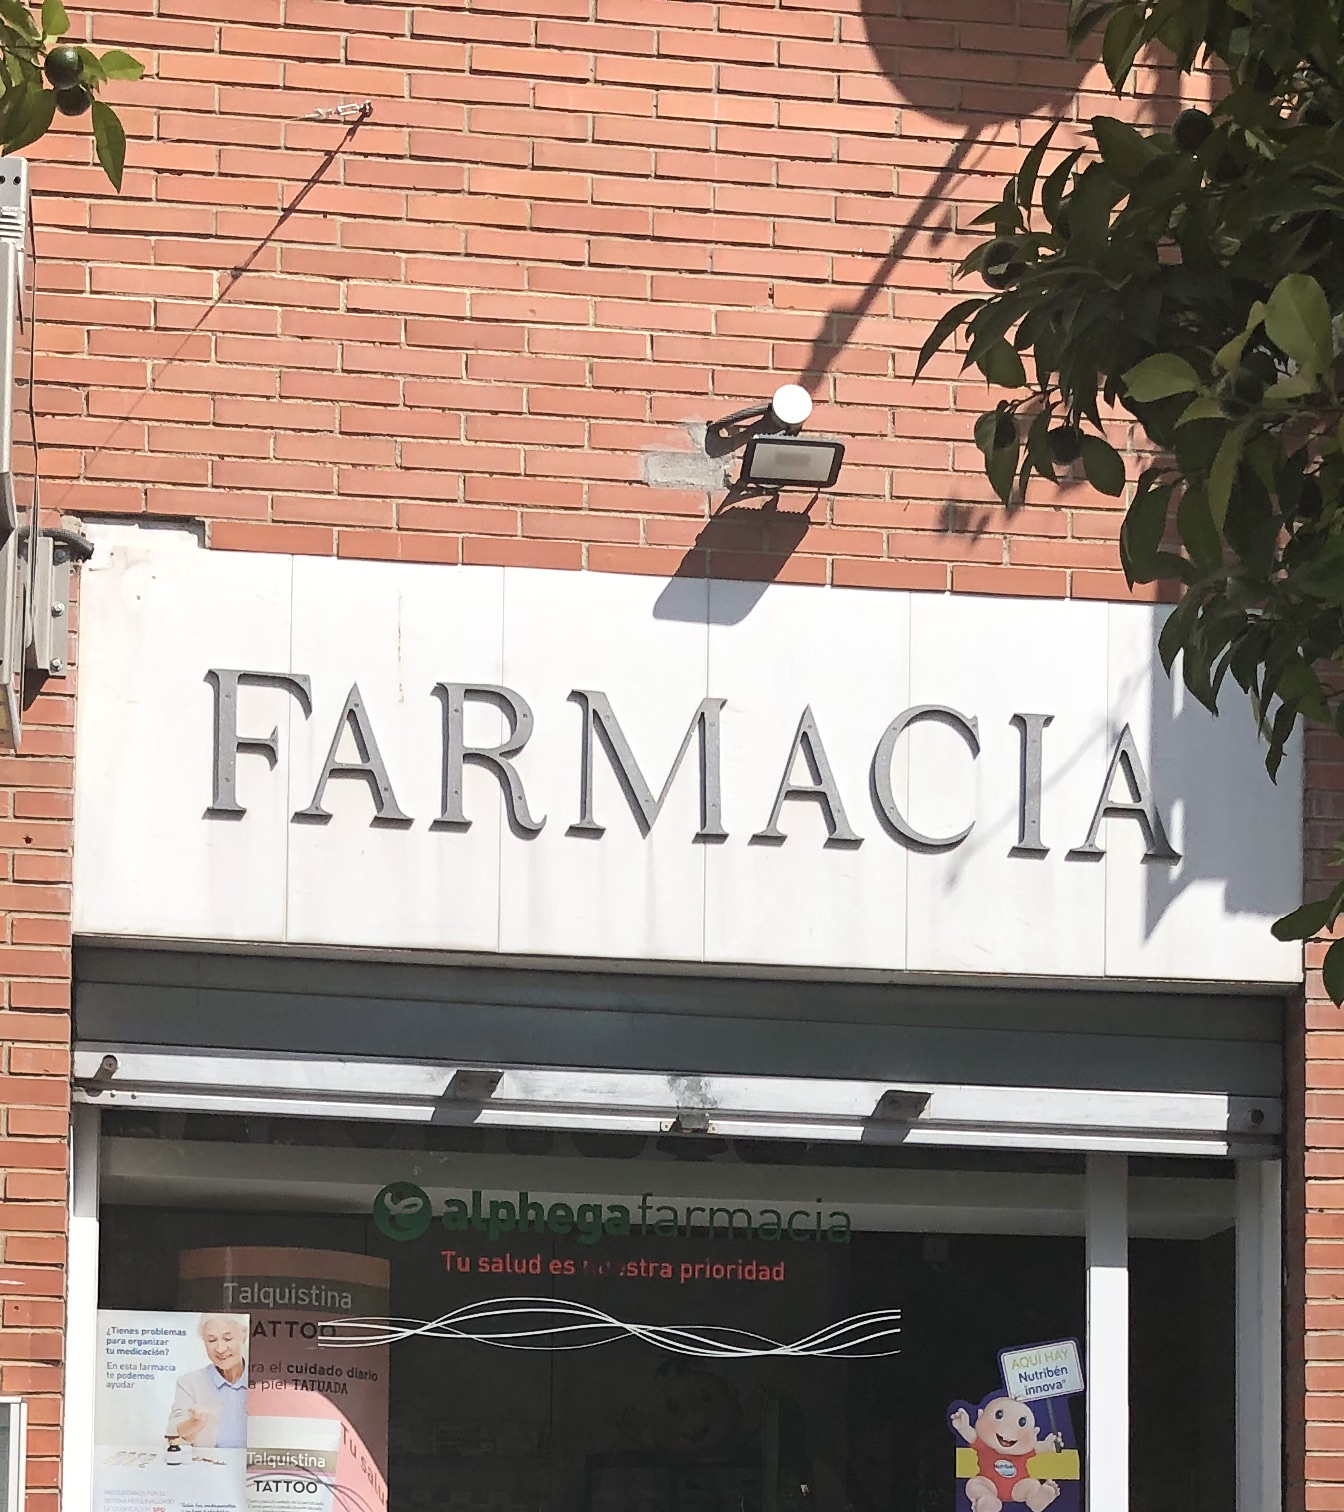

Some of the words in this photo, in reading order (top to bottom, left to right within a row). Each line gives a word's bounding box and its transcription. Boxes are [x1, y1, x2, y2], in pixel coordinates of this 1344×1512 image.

[201, 667, 1183, 866] FARMACIA
[441, 1250, 471, 1274] Tu
[477, 1252, 542, 1276] salud
[549, 1257, 576, 1276] es
[679, 1258, 786, 1284] prioridad
[223, 1281, 353, 1310] Talquistina
[106, 1327, 140, 1336] ¿Tienes
[141, 1327, 187, 1337] problemas
[252, 1320, 337, 1339] ATTOO
[106, 1338, 126, 1346] para
[127, 1337, 169, 1347] organizar
[116, 1347, 169, 1356] medicación?
[1011, 1352, 1042, 1370] AQUÍ
[1044, 1348, 1070, 1363] HAY
[107, 1362, 118, 1370] En
[120, 1363, 138, 1371] esta
[139, 1363, 176, 1372] farmacia
[286, 1362, 343, 1378] cuidado
[346, 1366, 378, 1381] diario
[1018, 1365, 1068, 1384] Nutribén
[116, 1372, 155, 1382] podemos
[106, 1381, 134, 1390] ayudar
[261, 1379, 287, 1392] piel
[291, 1379, 349, 1395] TATUADA
[247, 1452, 326, 1468] Talquistina
[254, 1480, 318, 1494] TATTOO
